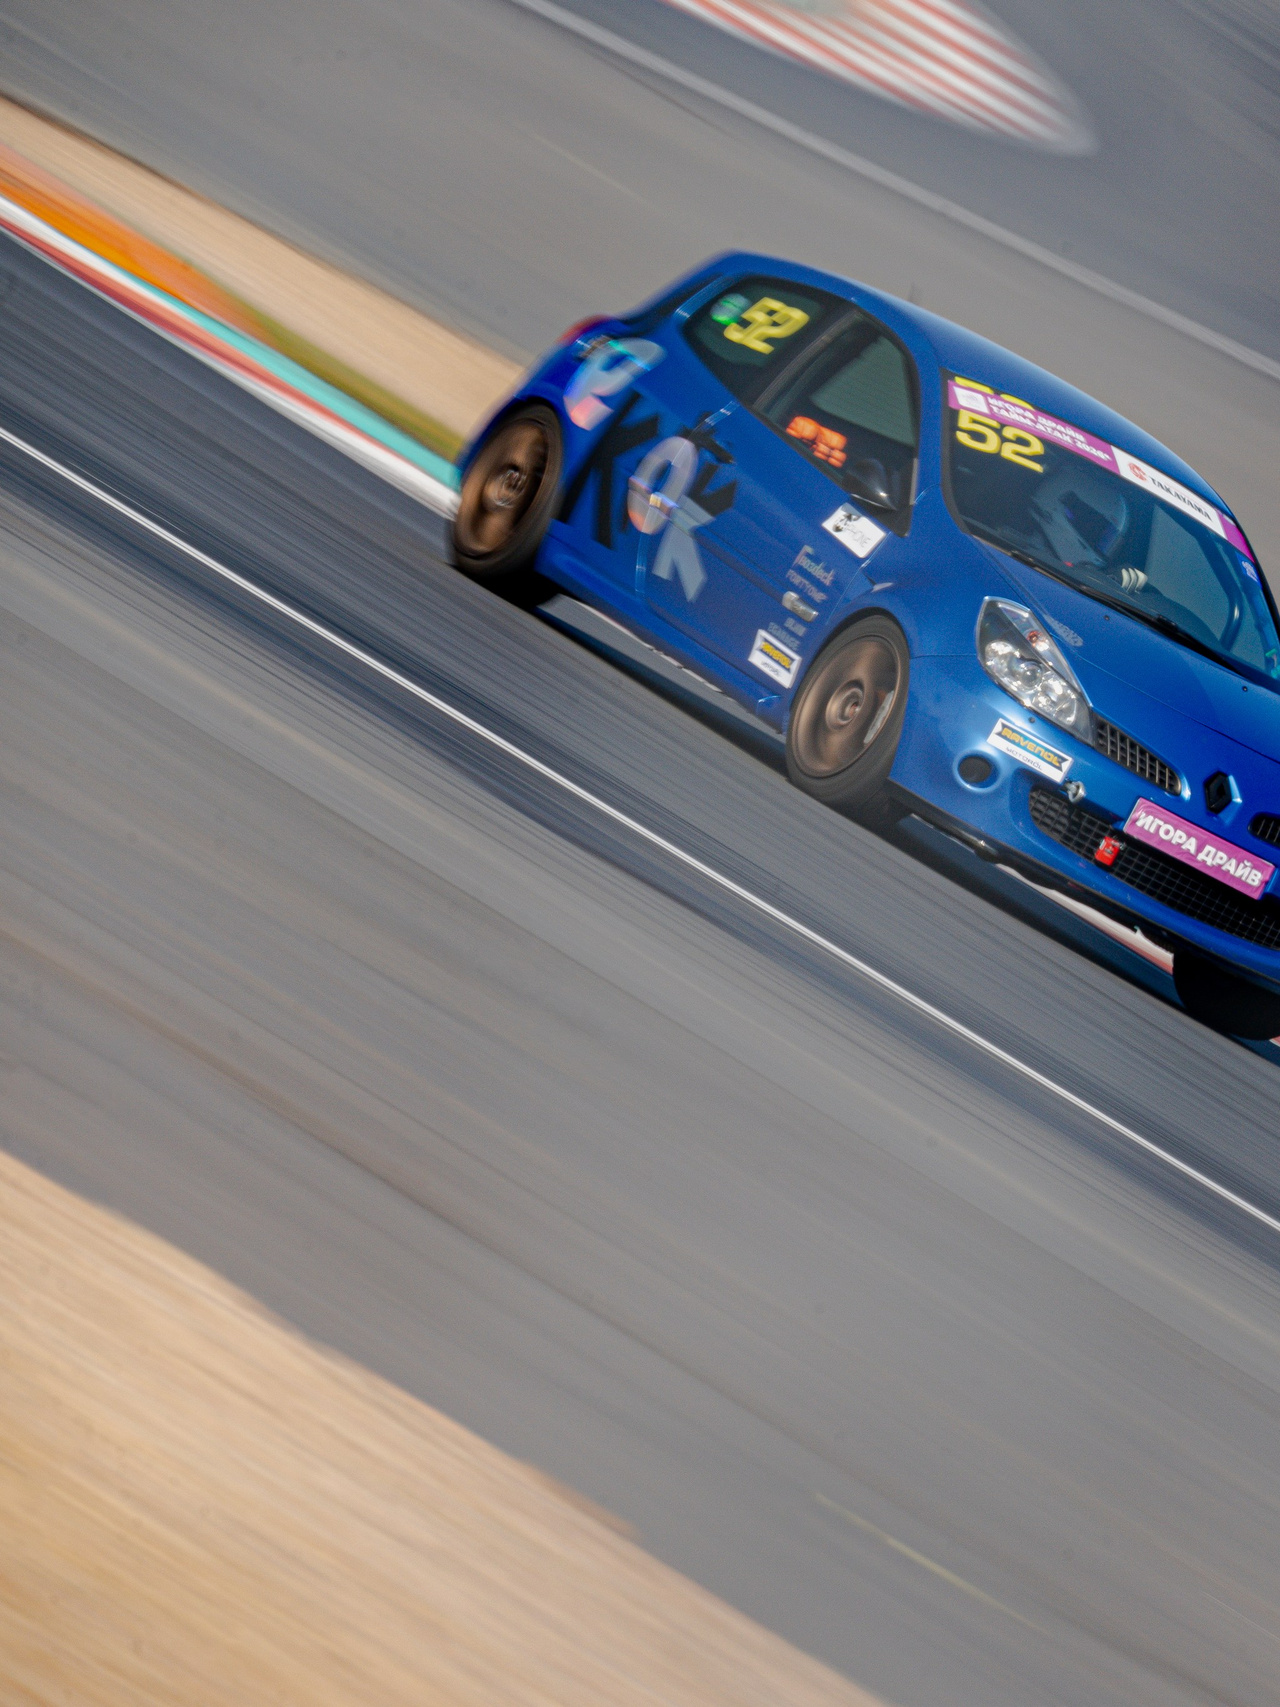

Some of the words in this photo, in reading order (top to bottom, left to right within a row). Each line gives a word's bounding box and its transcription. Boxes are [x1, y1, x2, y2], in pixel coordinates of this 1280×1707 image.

[723, 297, 810, 355] 52
[956, 408, 1046, 474] 52
[1148, 475, 1213, 522] TAKAYAMA
[1001, 727, 1061, 767] RAVENOL
[1135, 810, 1198, 856] ИГОРА
[1195, 844, 1264, 888] ДРАЙВ
